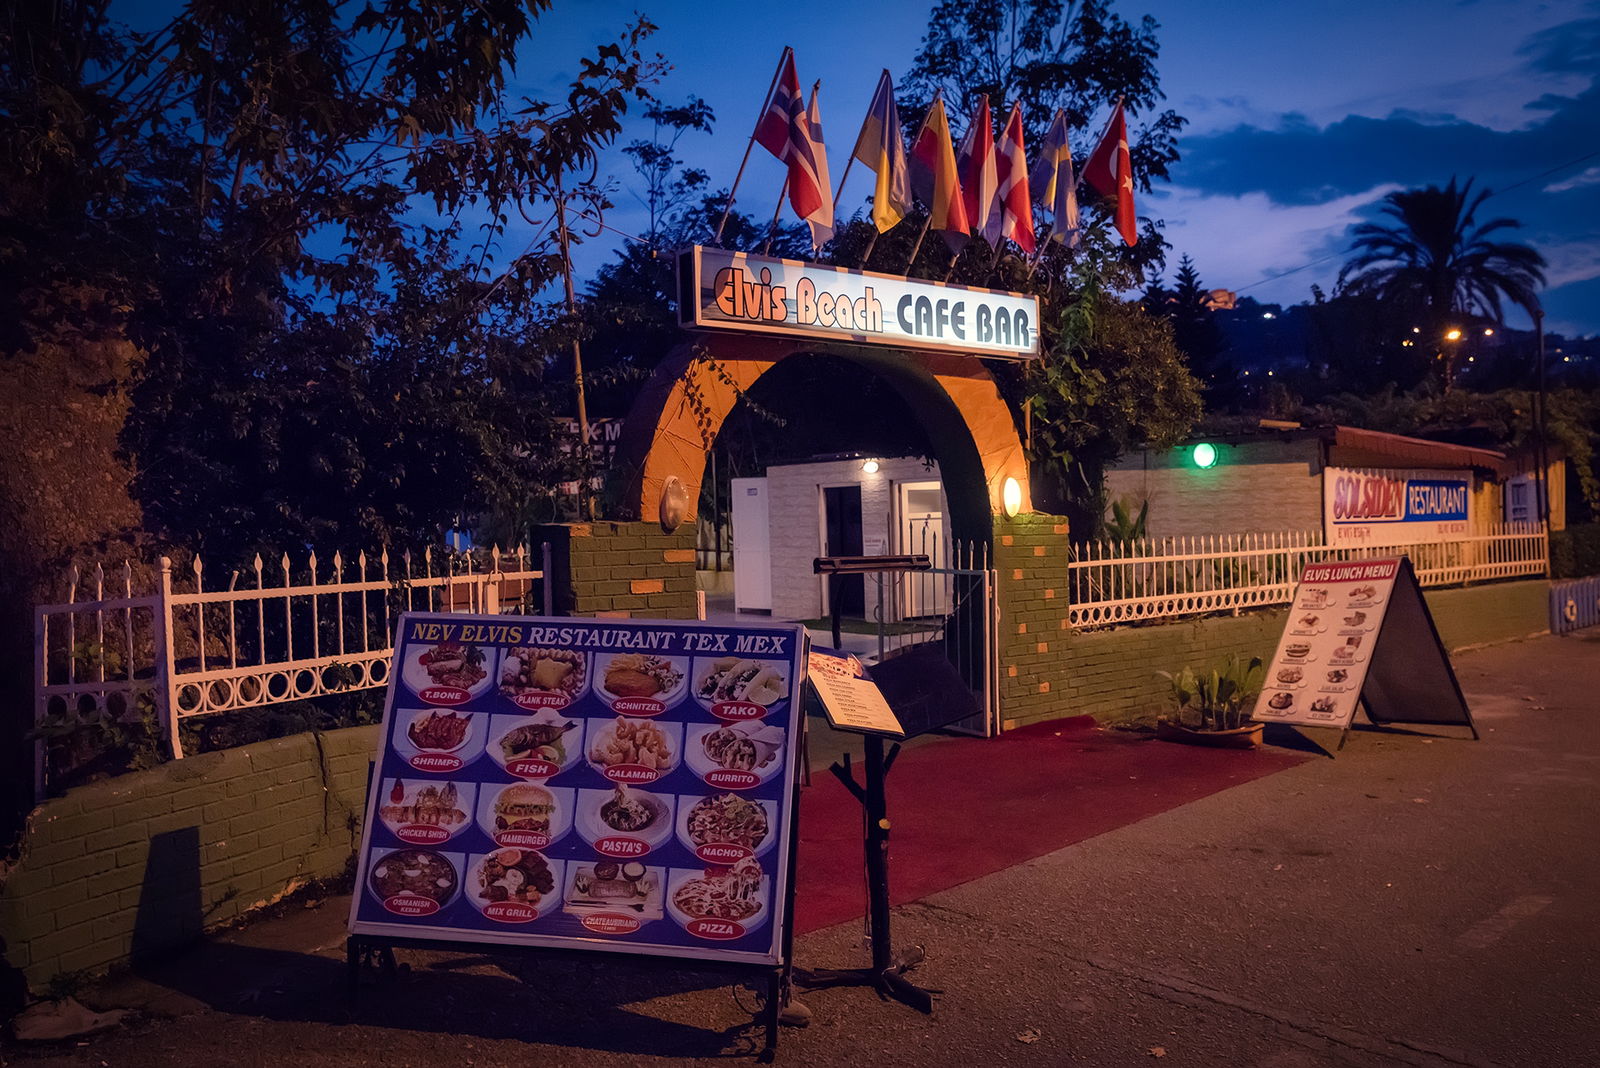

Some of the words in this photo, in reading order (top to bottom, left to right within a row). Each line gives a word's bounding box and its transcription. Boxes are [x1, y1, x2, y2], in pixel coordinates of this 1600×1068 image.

[713, 266, 788, 322] Elvis
[797, 276, 883, 333] Beach
[897, 293, 966, 341] CAFE
[976, 303, 1030, 348] BAR
[1409, 486, 1465, 515] RESTAURANT
[1304, 568, 1330, 581] ELVIS
[1331, 566, 1362, 580] LUNCH
[1363, 564, 1394, 578] MENU
[411, 623, 457, 641] NEV
[459, 625, 523, 643] ELVIS
[528, 627, 676, 650] RESTAURANT
[682, 632, 730, 652] TEX
[733, 635, 787, 654] MEX
[425, 692, 462, 700] T.BONE
[518, 696, 542, 705] PLANK
[543, 697, 566, 706] STEAK
[615, 702, 662, 712] SCHNITZEL
[722, 706, 757, 716] TAKO
[412, 757, 460, 767] SHRIMPS
[515, 764, 548, 774] FISH
[608, 769, 656, 779] CALAMARI
[710, 773, 754, 783] BURRITO
[399, 829, 428, 838] CHICKEN
[428, 831, 448, 839] SHISH
[500, 835, 547, 845] HAMBURGER
[602, 841, 642, 854] PASTA'S
[702, 848, 744, 858] NACHOS
[392, 900, 431, 908] OSMANISH
[487, 907, 504, 916] MIX
[506, 908, 533, 918] GRILL
[699, 924, 734, 935] PIZZA
